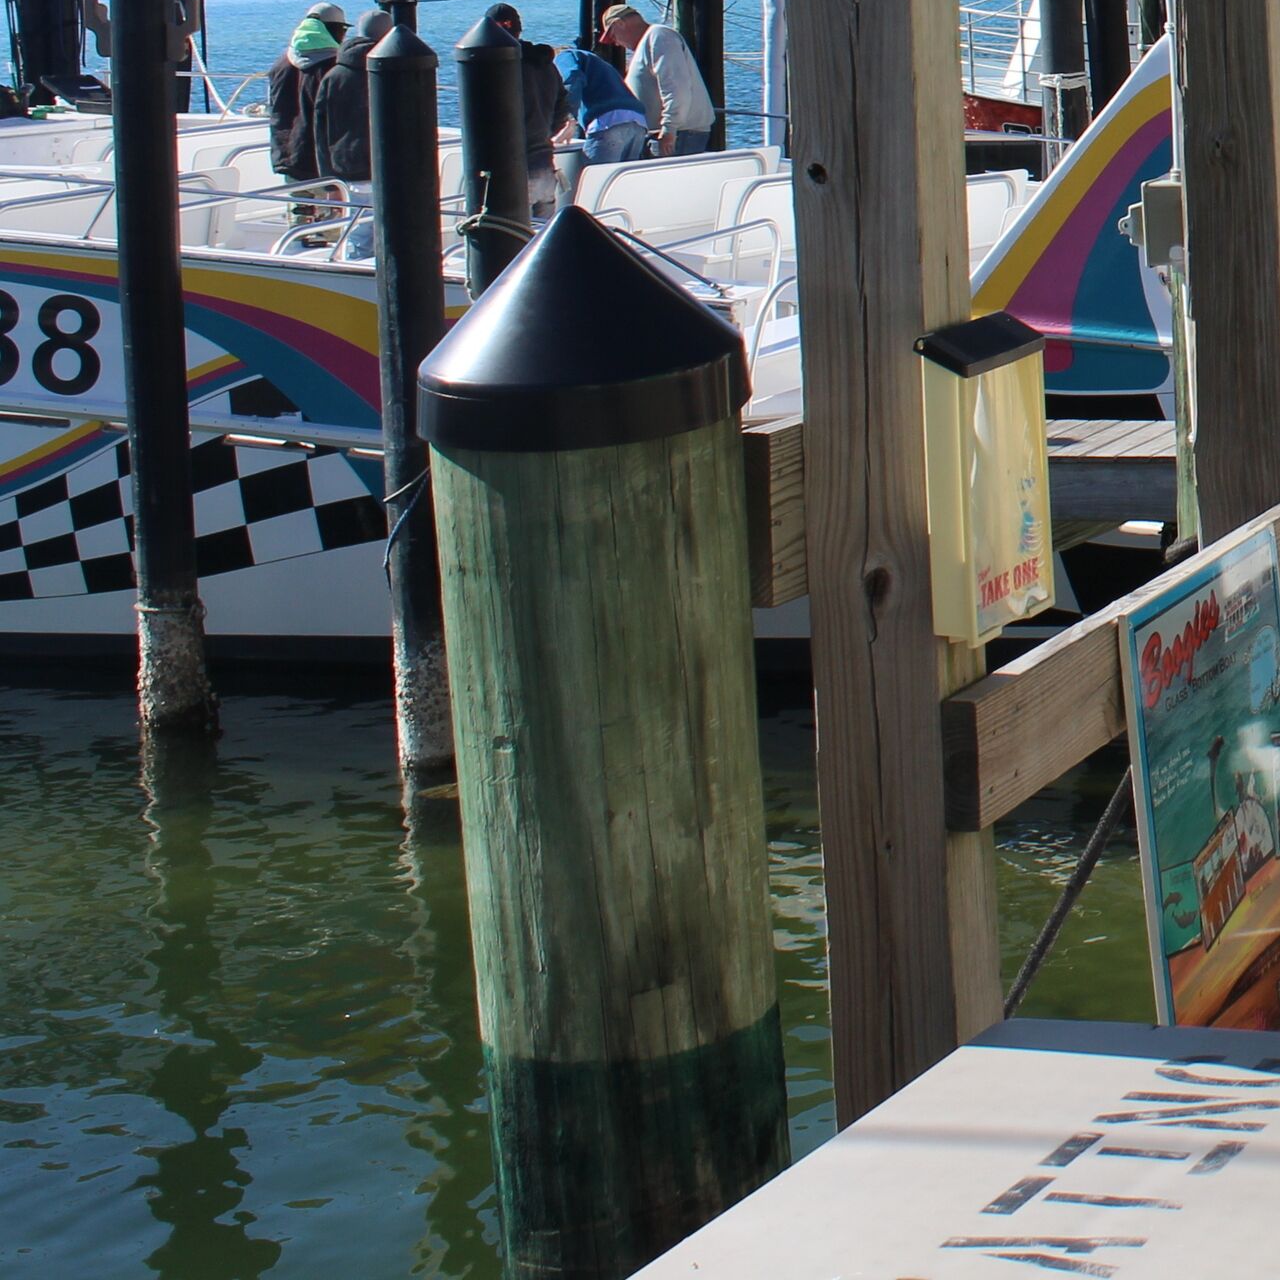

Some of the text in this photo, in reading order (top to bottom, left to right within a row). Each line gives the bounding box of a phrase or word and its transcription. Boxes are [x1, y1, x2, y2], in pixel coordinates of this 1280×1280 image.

[981, 557, 1039, 609] TAKE ONE
[1165, 652, 1237, 713] GLASS BOTTOM BOAT
